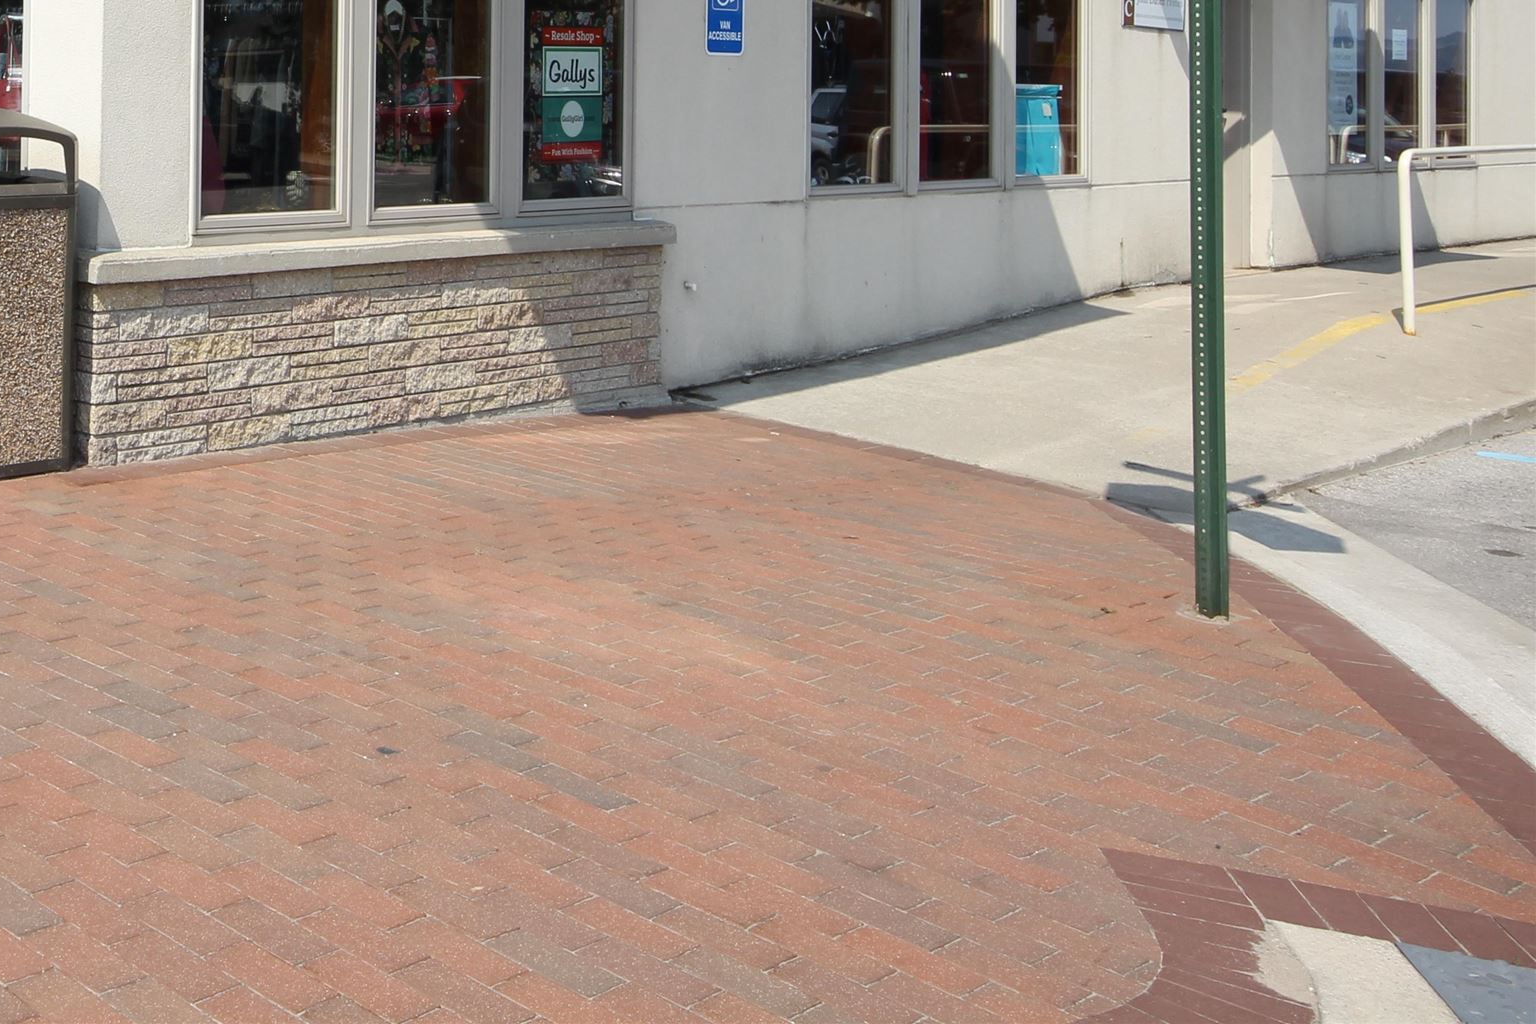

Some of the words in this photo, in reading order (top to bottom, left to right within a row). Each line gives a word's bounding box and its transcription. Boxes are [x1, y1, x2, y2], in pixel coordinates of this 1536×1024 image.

[1125, 0, 1133, 17] C
[719, 20, 731, 30] VAN
[551, 31, 575, 41] Resale
[576, 31, 595, 44] Shop
[708, 31, 742, 41] ACCESSIBLE
[548, 59, 595, 89] Gallys
